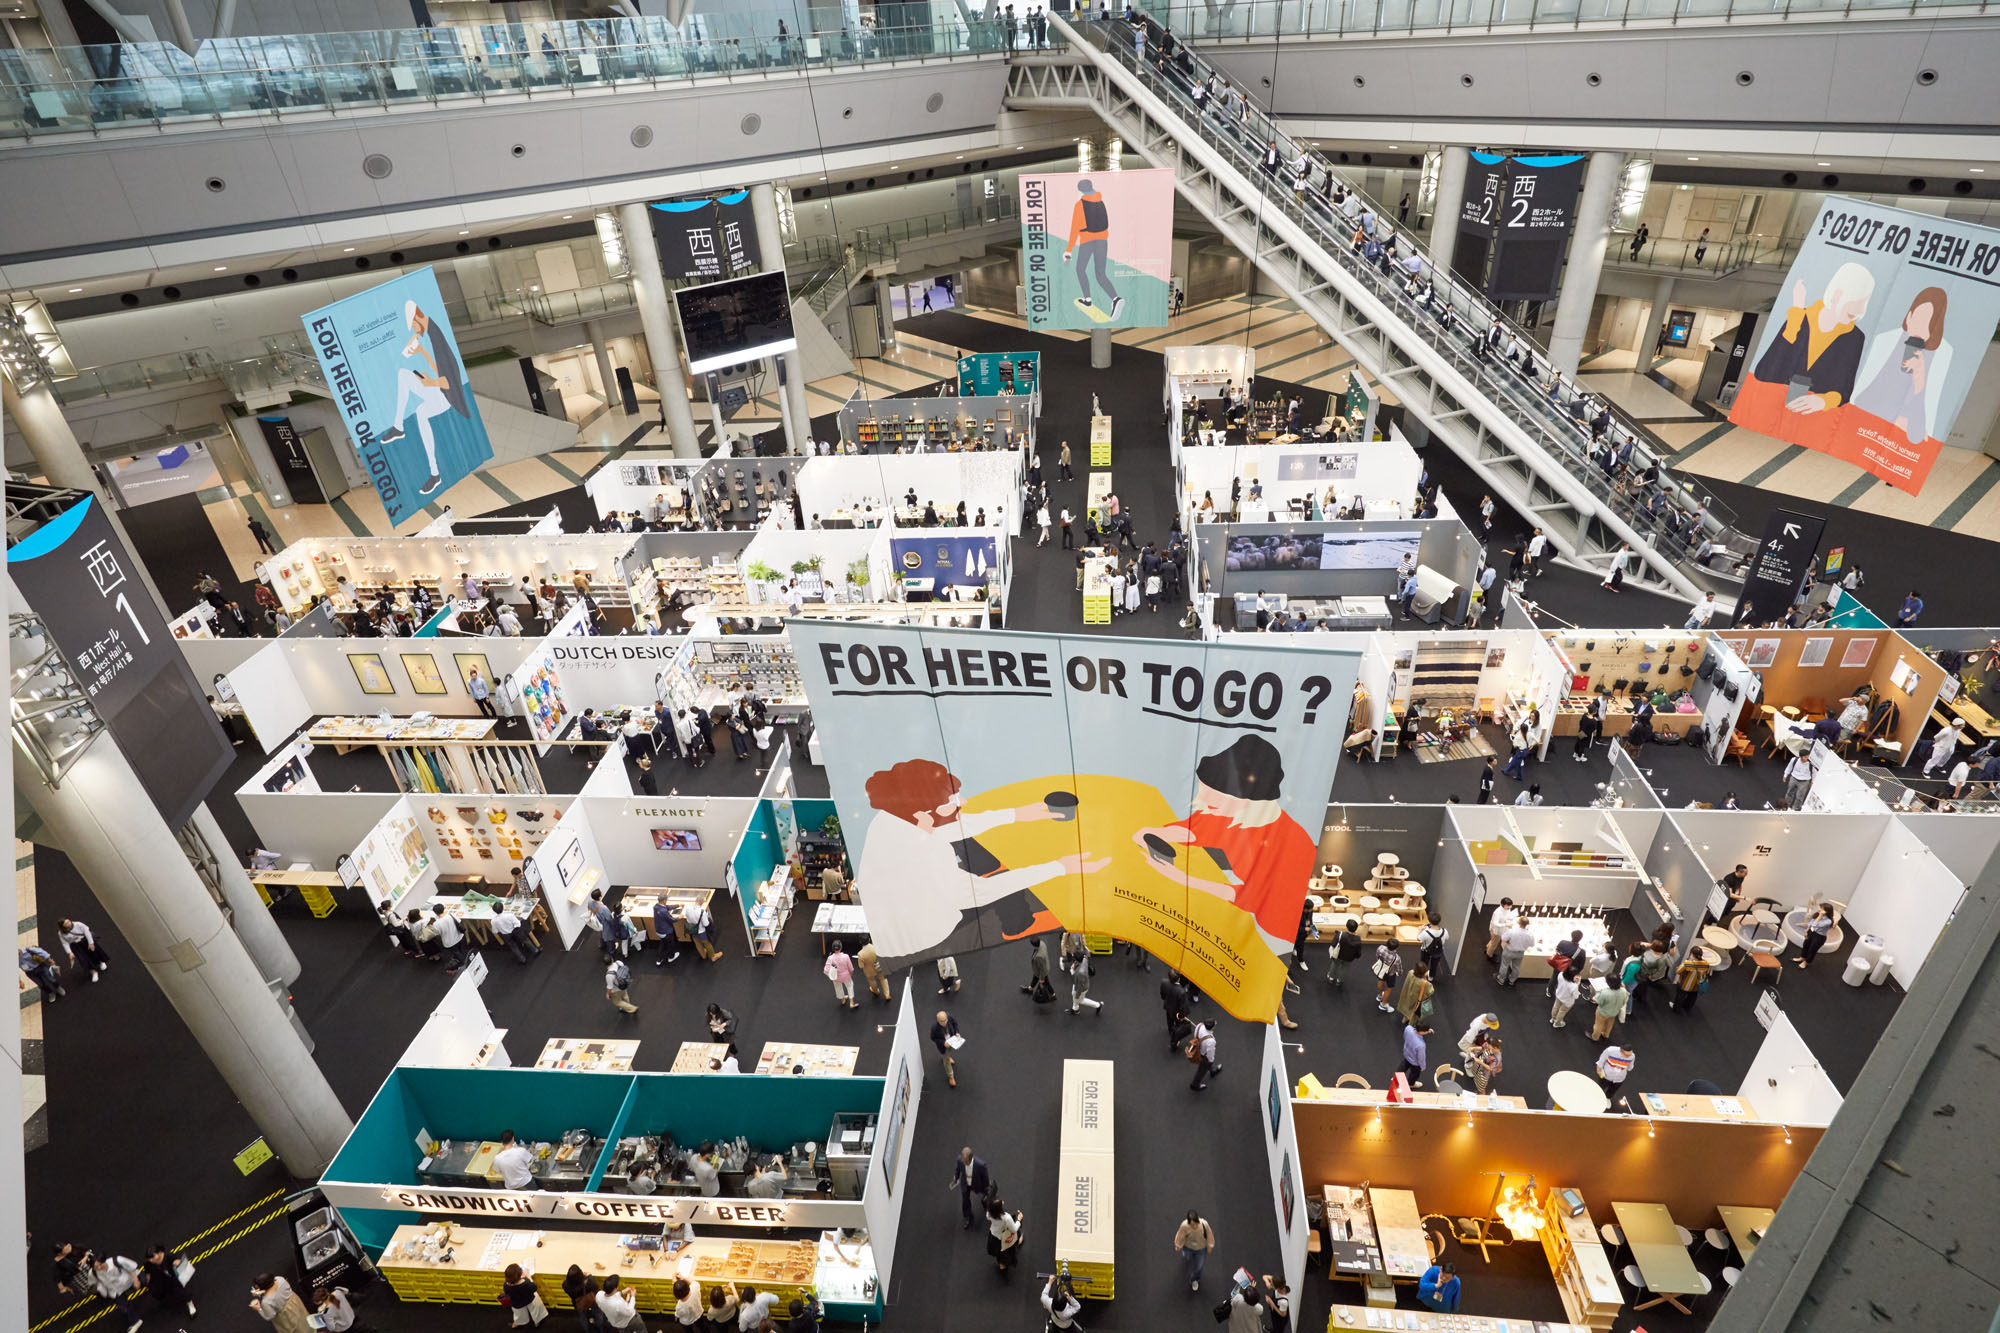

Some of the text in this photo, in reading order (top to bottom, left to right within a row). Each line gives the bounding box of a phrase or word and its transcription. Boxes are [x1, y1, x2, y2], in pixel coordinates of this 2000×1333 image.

[1485, 173, 1499, 196] 西
[1513, 175, 1537, 198] 西
[1480, 197, 1493, 225] 2
[1507, 198, 1529, 227] 2
[1532, 208, 1564, 216] 西2ホール
[686, 227, 715, 257] 西
[724, 221, 742, 252] 西
[276, 425, 293, 440] 西
[285, 440, 297, 457] 1
[80, 539, 127, 598] 西
[115, 592, 150, 645] 1
[77, 628, 120, 670] 西1ホール
[92, 640, 127, 675] West Hall 1
[553, 646, 679, 660] DUTCH DESIG
[818, 642, 916, 686] FOR
[922, 646, 1052, 688] HERE
[1065, 655, 1129, 699] OR
[635, 808, 705, 817] FLEXNOTE
[1114, 886, 1247, 967] Interior Lifestyle Tokyo
[1218, 962, 1242, 988] 2018
[1084, 1080, 1098, 1129] FOR HERE
[398, 1193, 533, 1214] SANDWICH
[575, 1201, 675, 1219] COFFEE
[716, 1206, 785, 1222] BEER
[1074, 1175, 1090, 1234] FOR HERE
